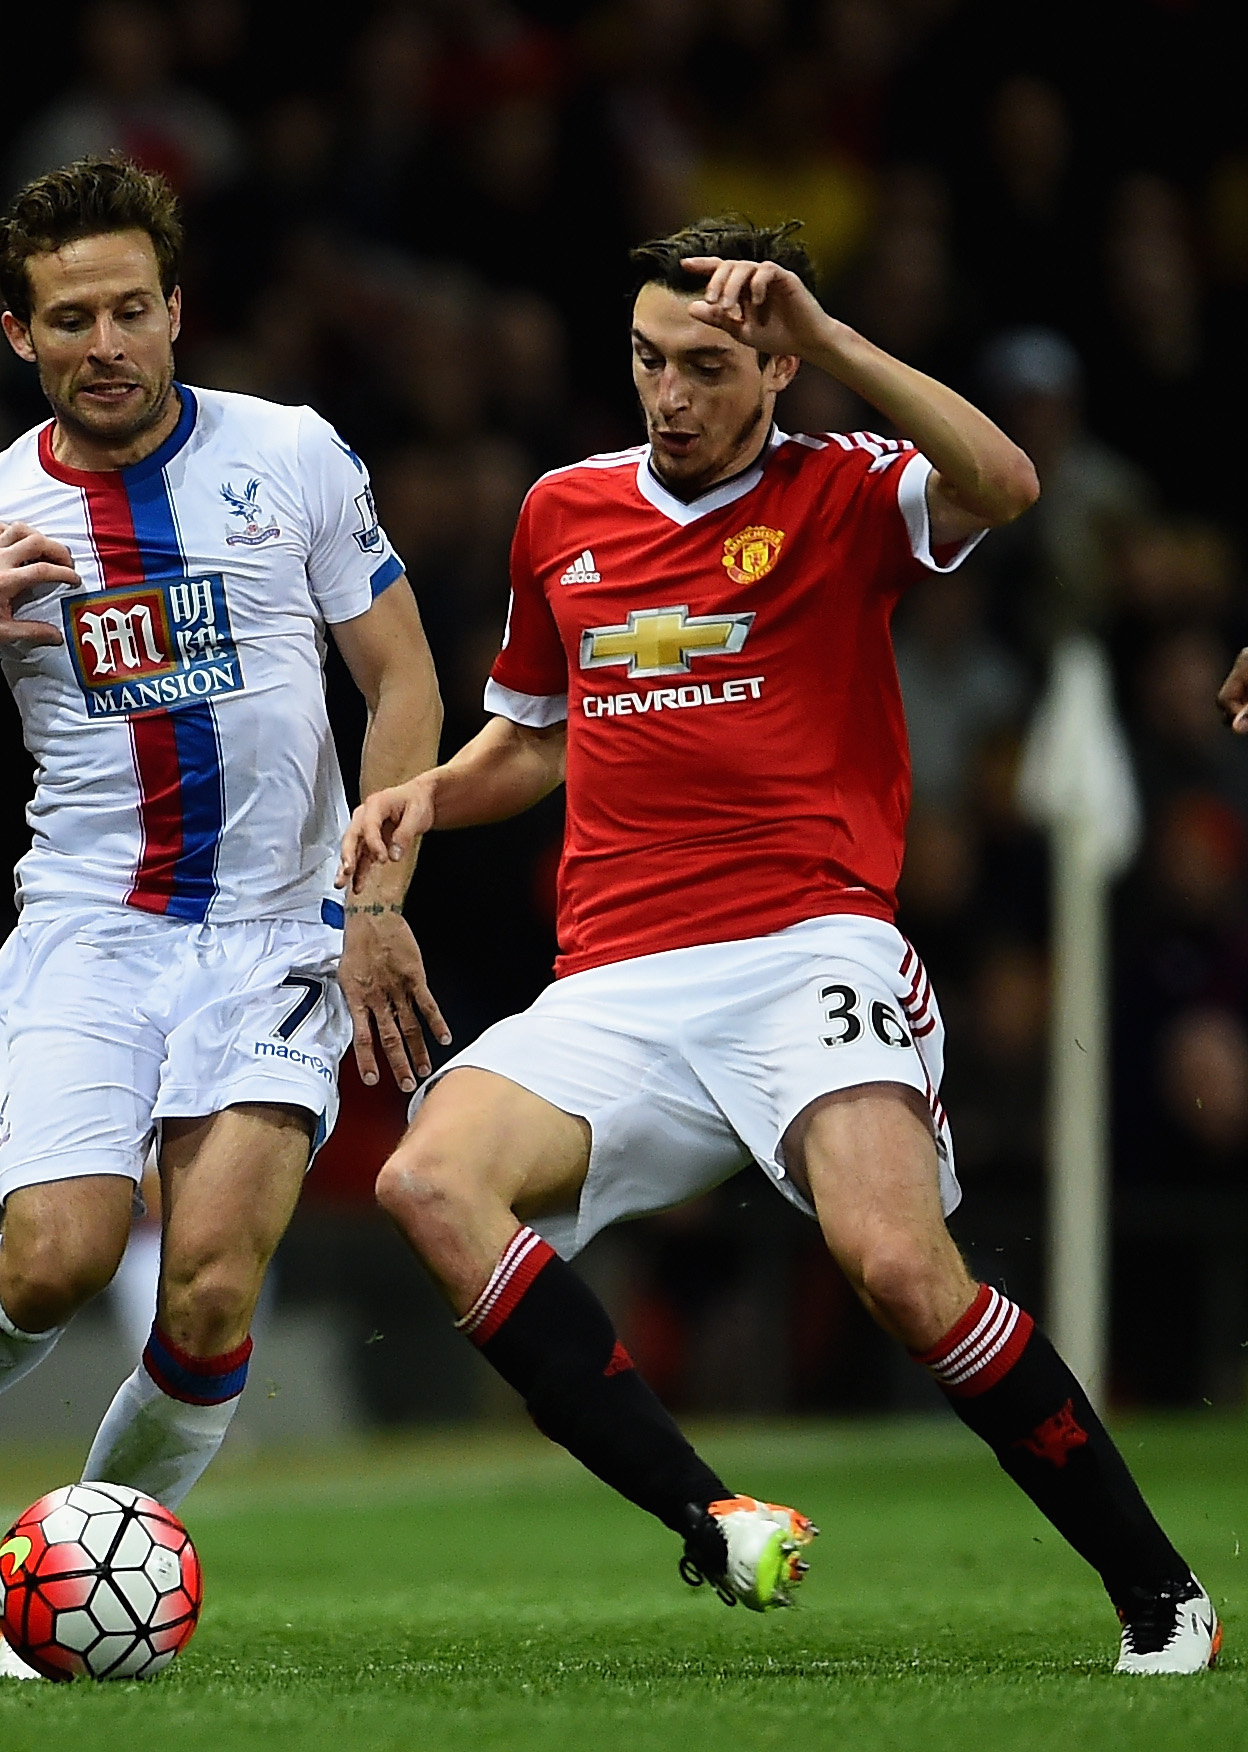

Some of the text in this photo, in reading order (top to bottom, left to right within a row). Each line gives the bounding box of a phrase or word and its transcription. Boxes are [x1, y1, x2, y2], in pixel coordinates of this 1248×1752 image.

[560, 570, 601, 586] adidas
[91, 662, 237, 715] MANSION
[582, 676, 765, 718] CHEVROLET
[273, 975, 325, 1043] 7
[820, 984, 914, 1048] 36
[254, 1041, 333, 1084] macron
